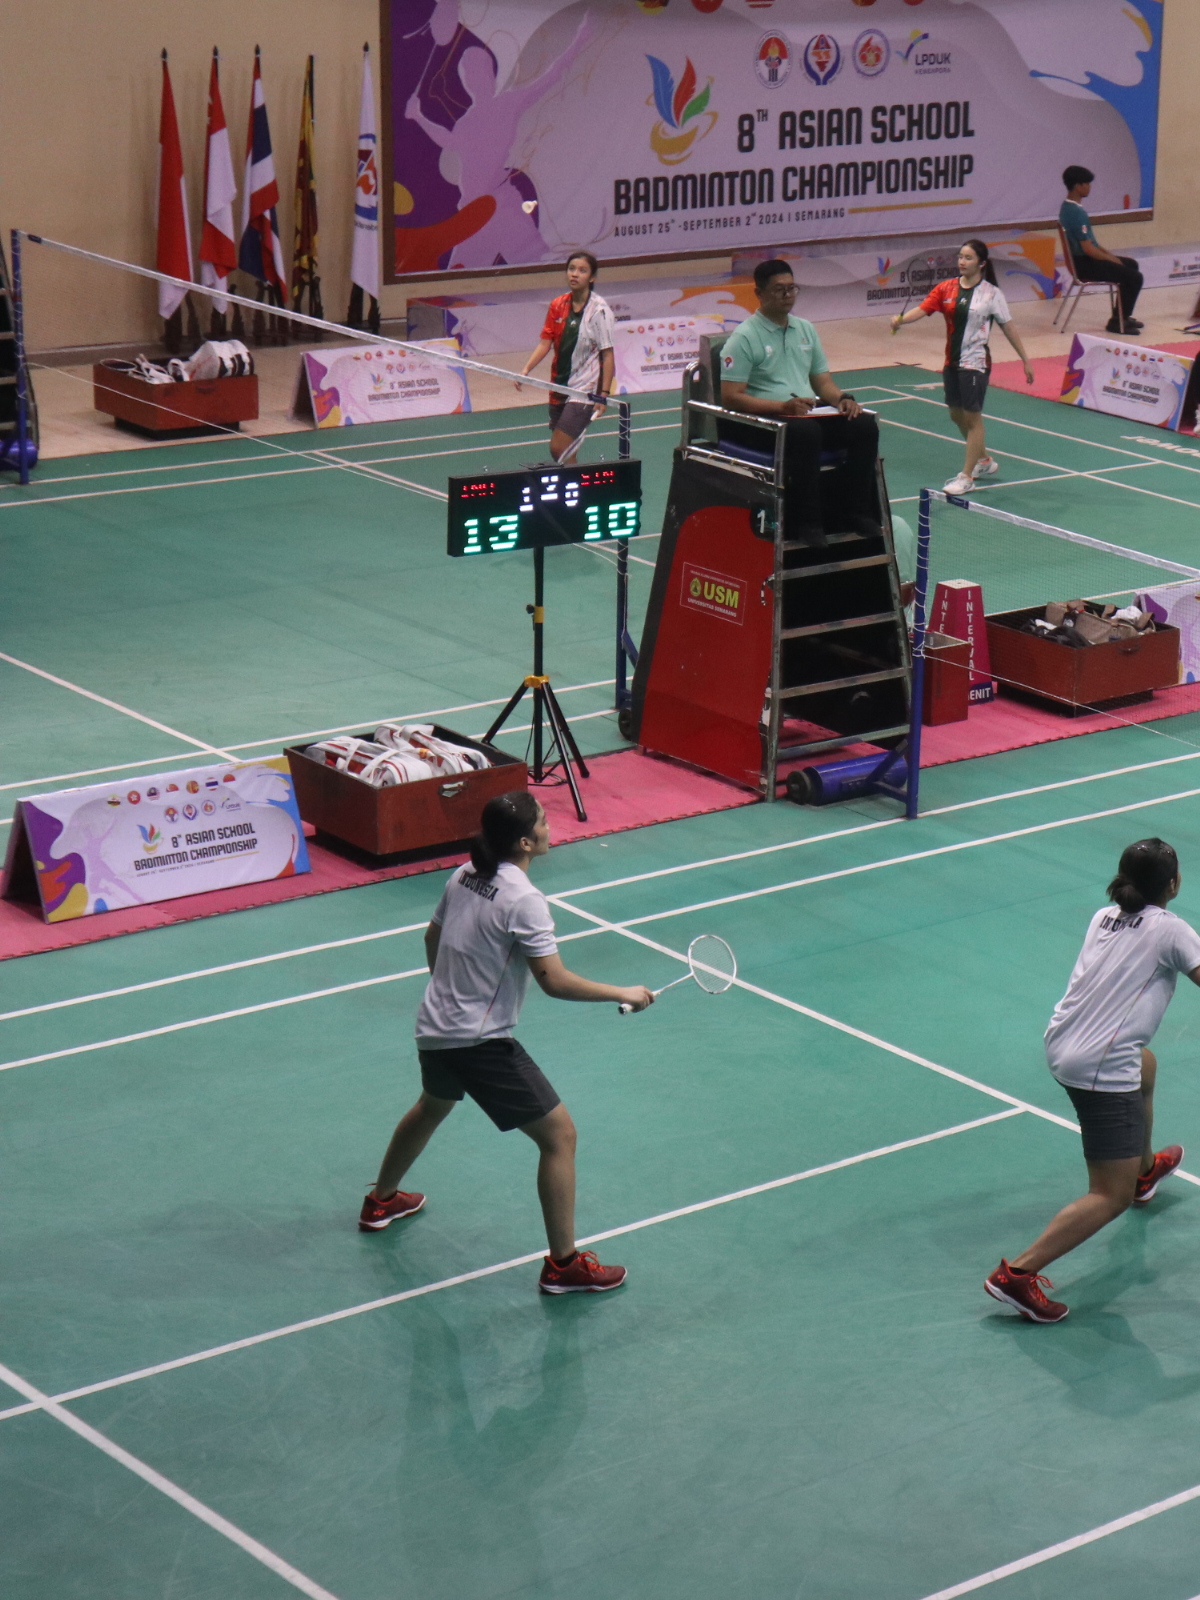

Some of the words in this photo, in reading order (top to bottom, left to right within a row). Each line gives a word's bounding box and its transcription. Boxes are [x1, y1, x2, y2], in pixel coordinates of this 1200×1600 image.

[915, 52, 951, 66] LPDUK
[778, 106, 863, 151] ASIAN
[870, 101, 975, 145] SCHOOL
[614, 168, 774, 216] BADMINTON
[782, 154, 975, 203] CHAMPIONSHIP
[614, 223, 653, 237] AUGUST
[758, 213, 784, 225] 2024
[795, 207, 845, 222] SEMARANG
[463, 514, 519, 554] 13
[584, 501, 637, 540] 10
[757, 509, 766, 534] 1
[704, 581, 739, 609] USM
[968, 687, 991, 701] ENIT
[185, 829, 215, 846] ASIAN
[217, 822, 256, 840] SCHOOL
[134, 851, 189, 871] BADMINTON
[189, 838, 258, 861] CHAMPIONSHIP
